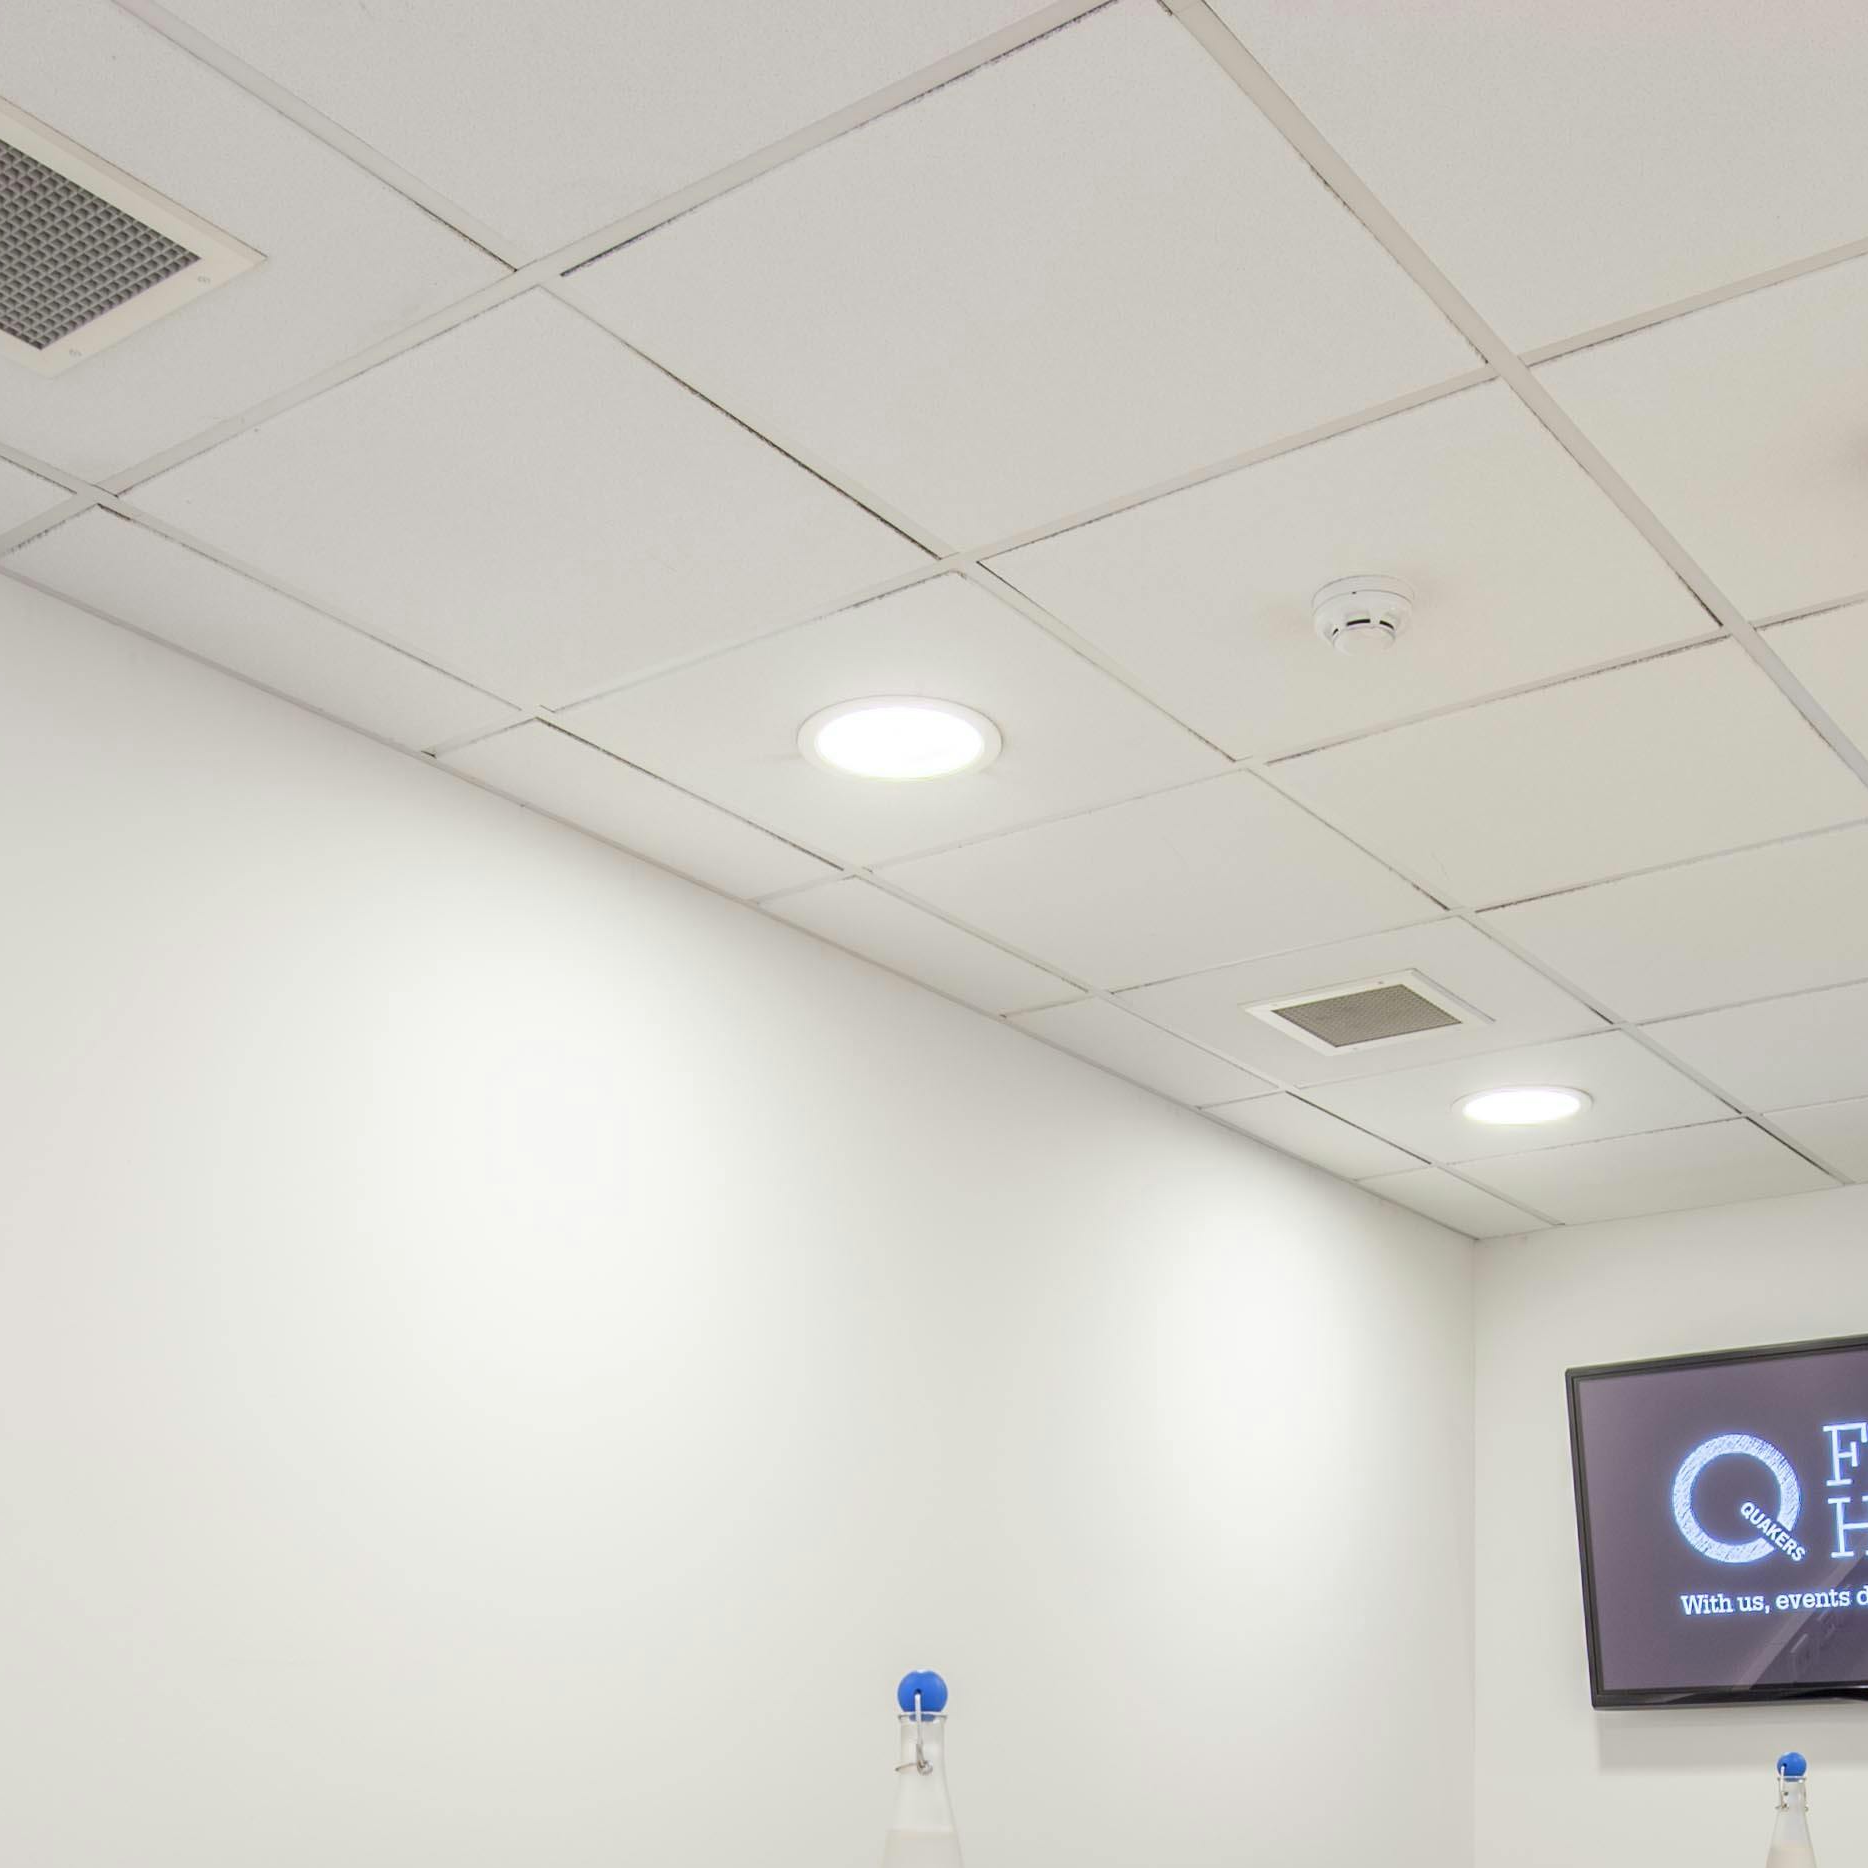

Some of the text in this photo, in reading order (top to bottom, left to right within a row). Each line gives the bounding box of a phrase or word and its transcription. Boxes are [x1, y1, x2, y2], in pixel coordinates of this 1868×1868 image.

[1739, 1500, 1807, 1563] QUAKERS
[1680, 1593, 1734, 1616] With
[1736, 1595, 1771, 1614] us,
[1775, 1588, 1852, 1611] events
